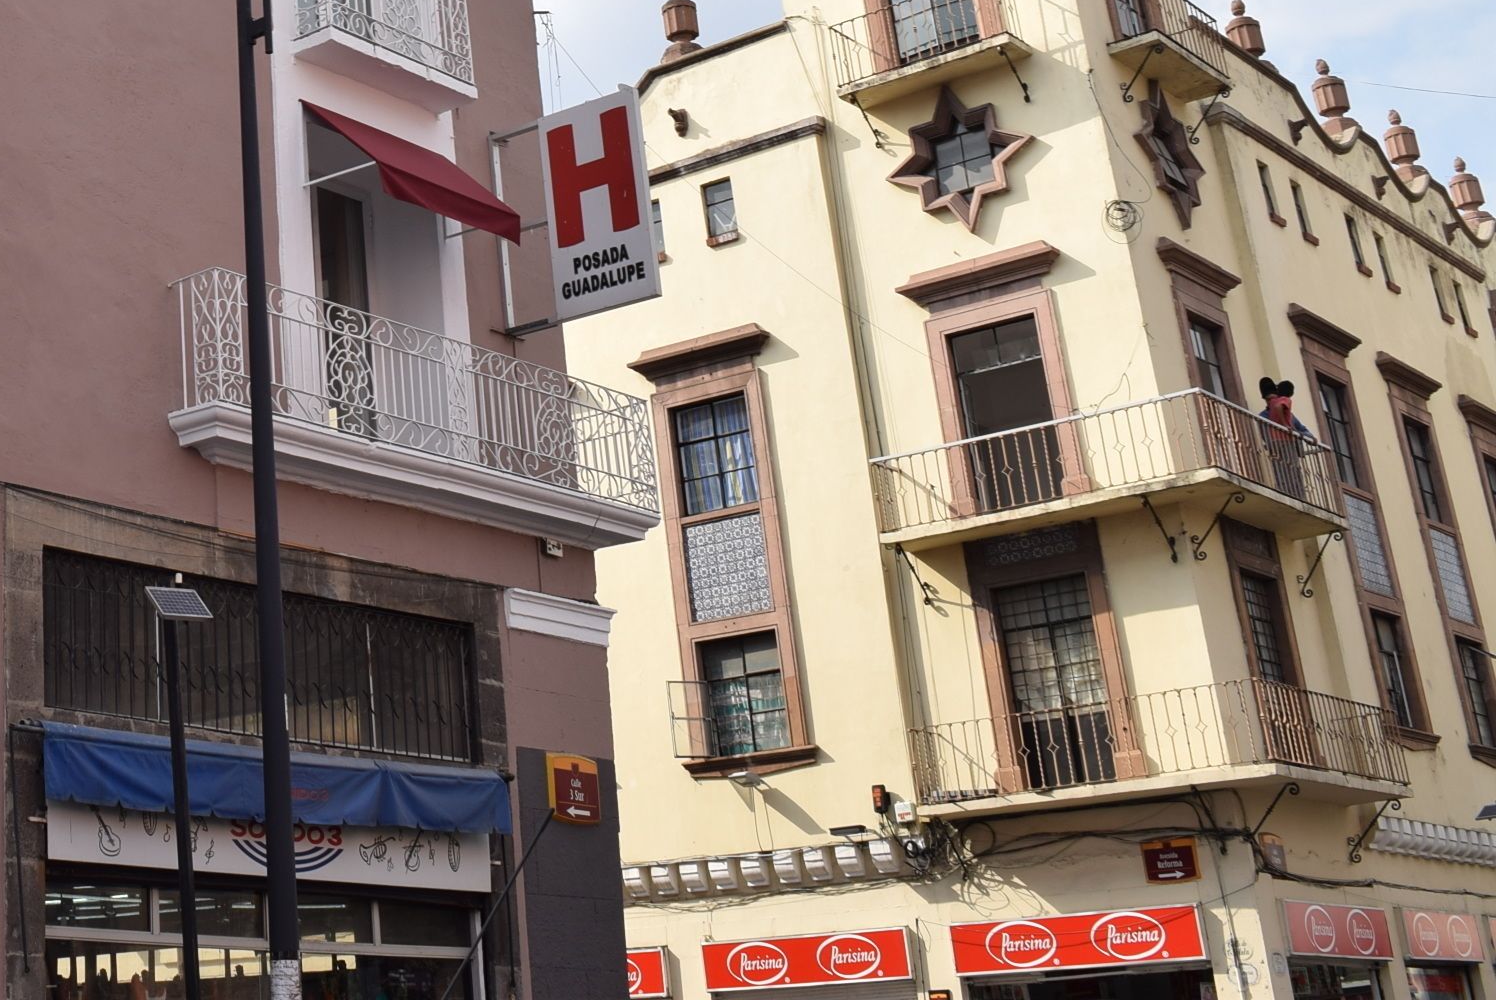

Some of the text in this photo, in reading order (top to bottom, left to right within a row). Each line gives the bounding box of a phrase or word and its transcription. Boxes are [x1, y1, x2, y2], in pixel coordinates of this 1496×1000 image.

[547, 106, 640, 248] H
[573, 244, 629, 275] POSADA
[562, 261, 645, 300] GUADALUPE
[575, 790, 585, 801] Sur
[230, 818, 343, 846] SODO3
[1157, 860, 1184, 869] Reforma
[1001, 924, 1160, 952] Parisina Parisina
[740, 945, 876, 971] Parisina Parisina
